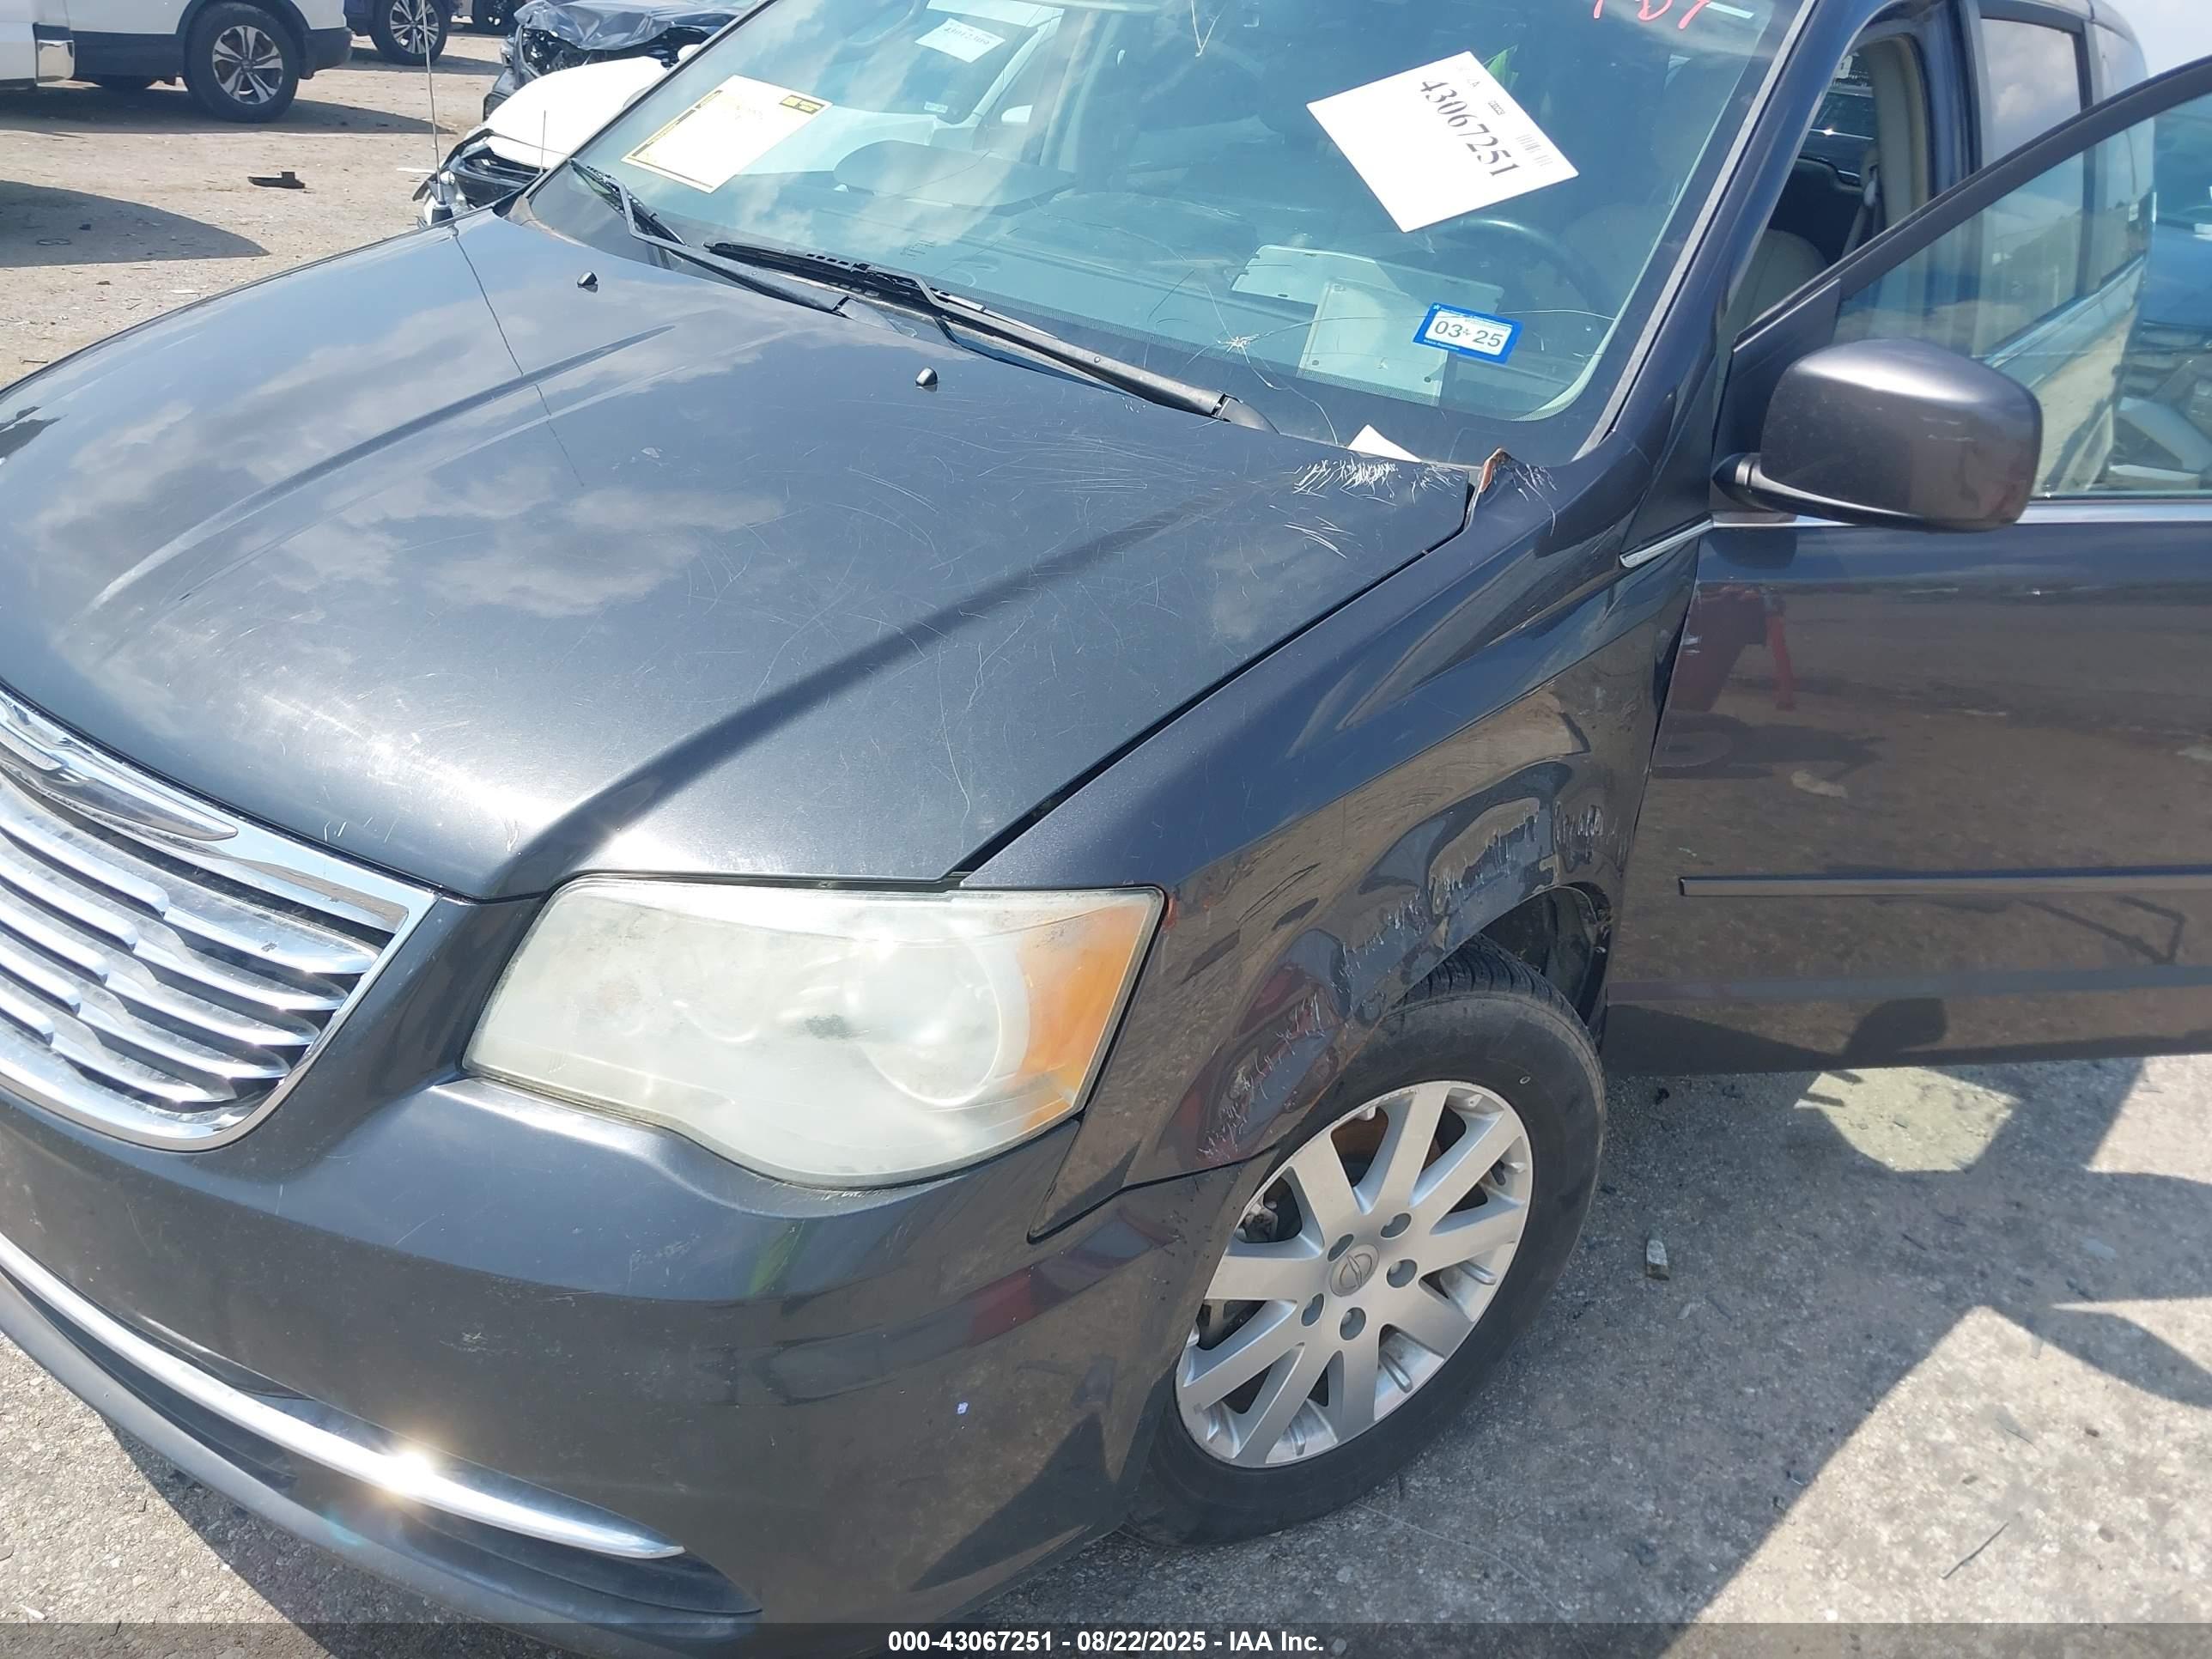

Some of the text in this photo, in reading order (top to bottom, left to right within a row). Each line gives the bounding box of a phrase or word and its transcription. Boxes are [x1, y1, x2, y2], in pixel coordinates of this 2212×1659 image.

[1420, 81, 1521, 176] 43067251
[1434, 320, 1463, 337] 03
[1473, 330, 1504, 347] 25
